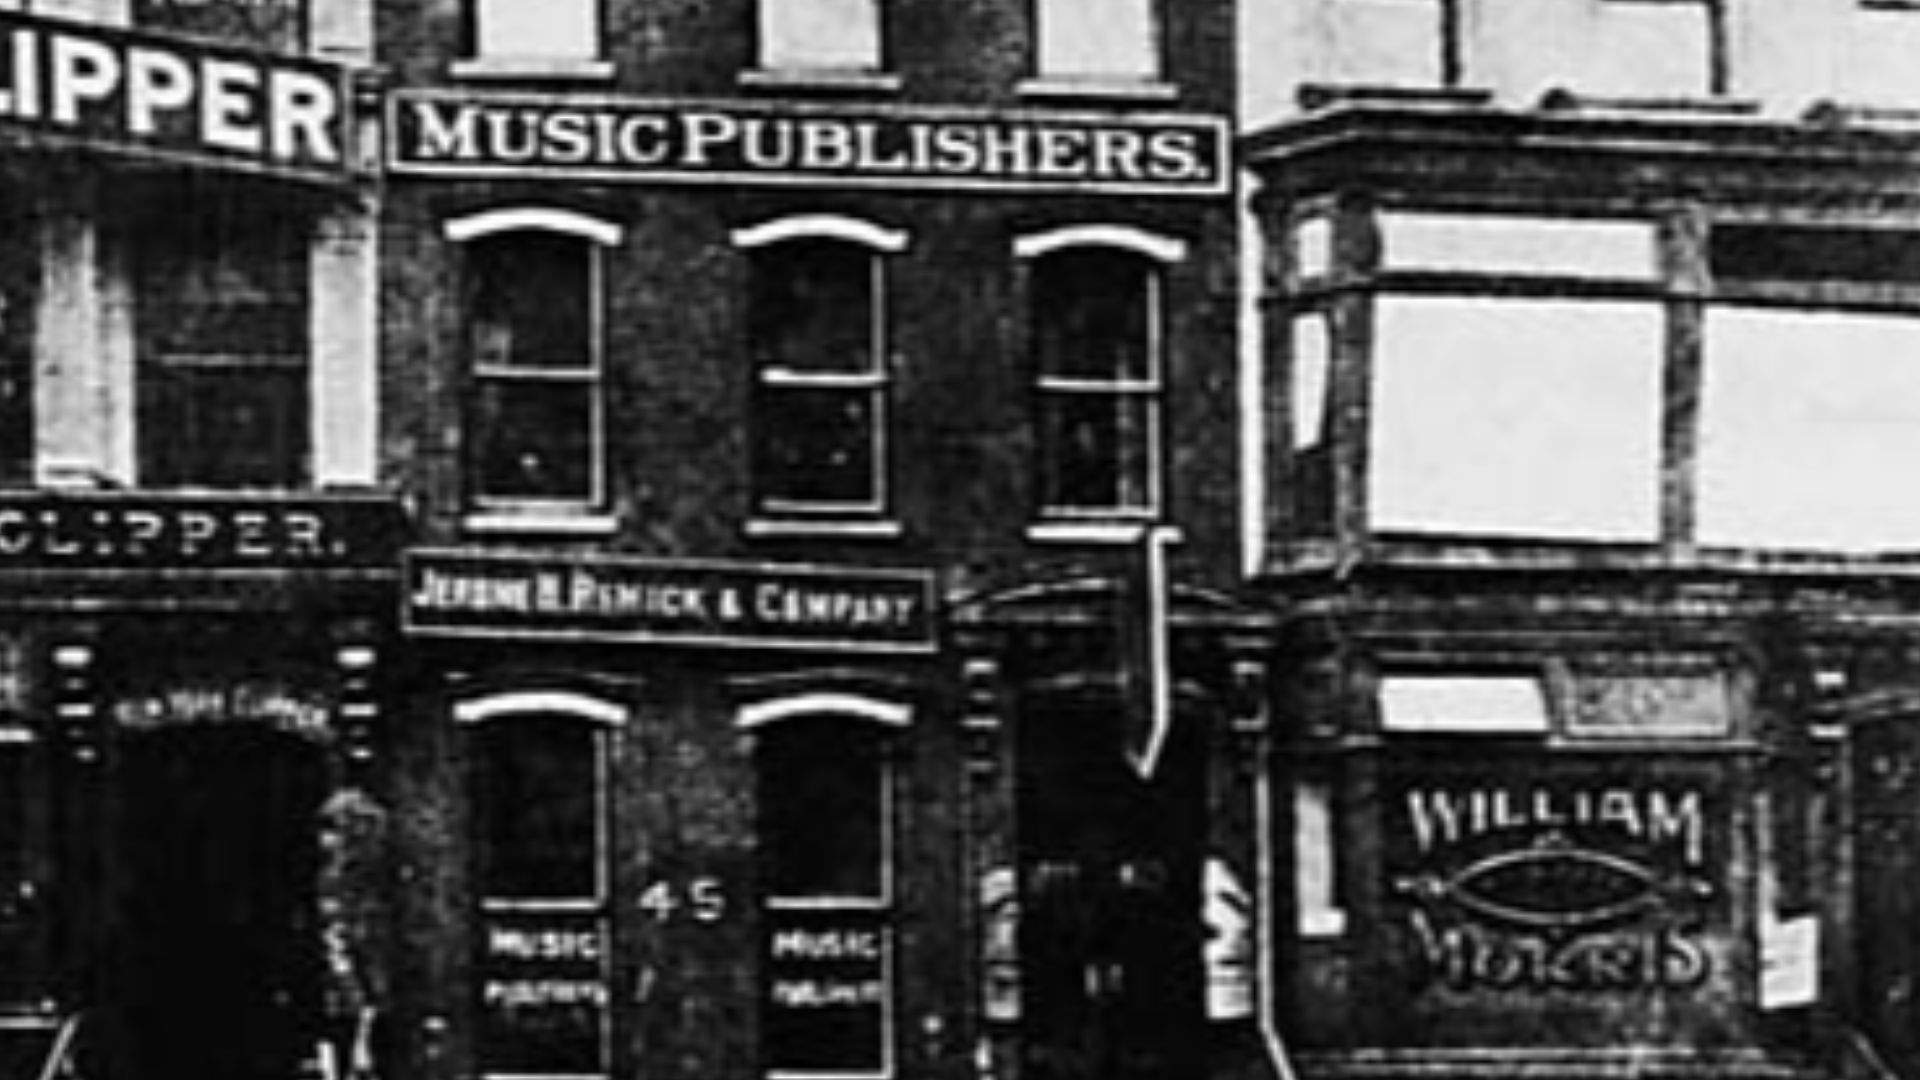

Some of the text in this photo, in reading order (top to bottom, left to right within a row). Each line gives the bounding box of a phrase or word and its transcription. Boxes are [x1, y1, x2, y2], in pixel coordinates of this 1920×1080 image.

[0, 28, 339, 162] IPPER
[412, 101, 1210, 179] MUSIC PUBLISHERS.
[756, 581, 915, 627] COMPANY
[1406, 786, 1702, 864] WILLIAM
[488, 927, 600, 959] MUSIC
[771, 927, 879, 959] MUSIC
